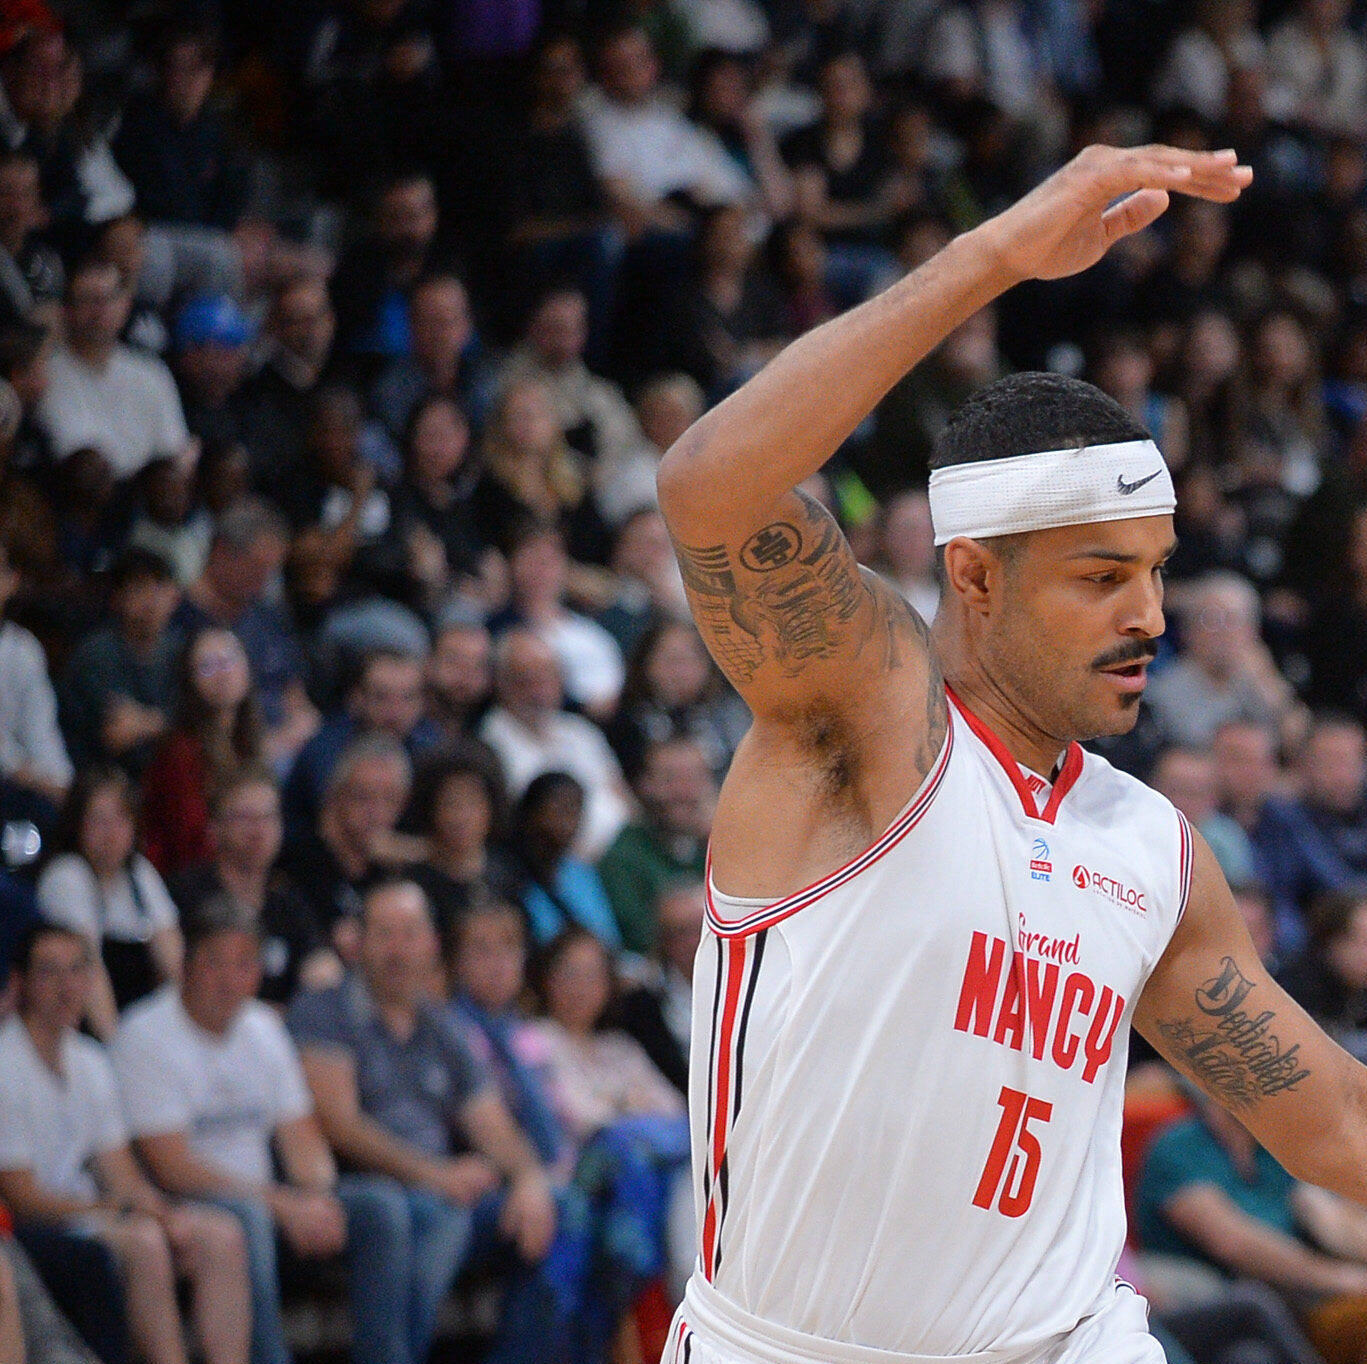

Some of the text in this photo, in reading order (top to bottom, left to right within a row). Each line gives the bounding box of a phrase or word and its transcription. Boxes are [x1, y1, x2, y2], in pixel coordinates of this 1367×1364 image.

[1092, 872, 1147, 912] ACTILOC
[1018, 912, 1080, 965] Grand
[954, 931, 1125, 1084] NANCY
[972, 1086, 1053, 1218] 15
